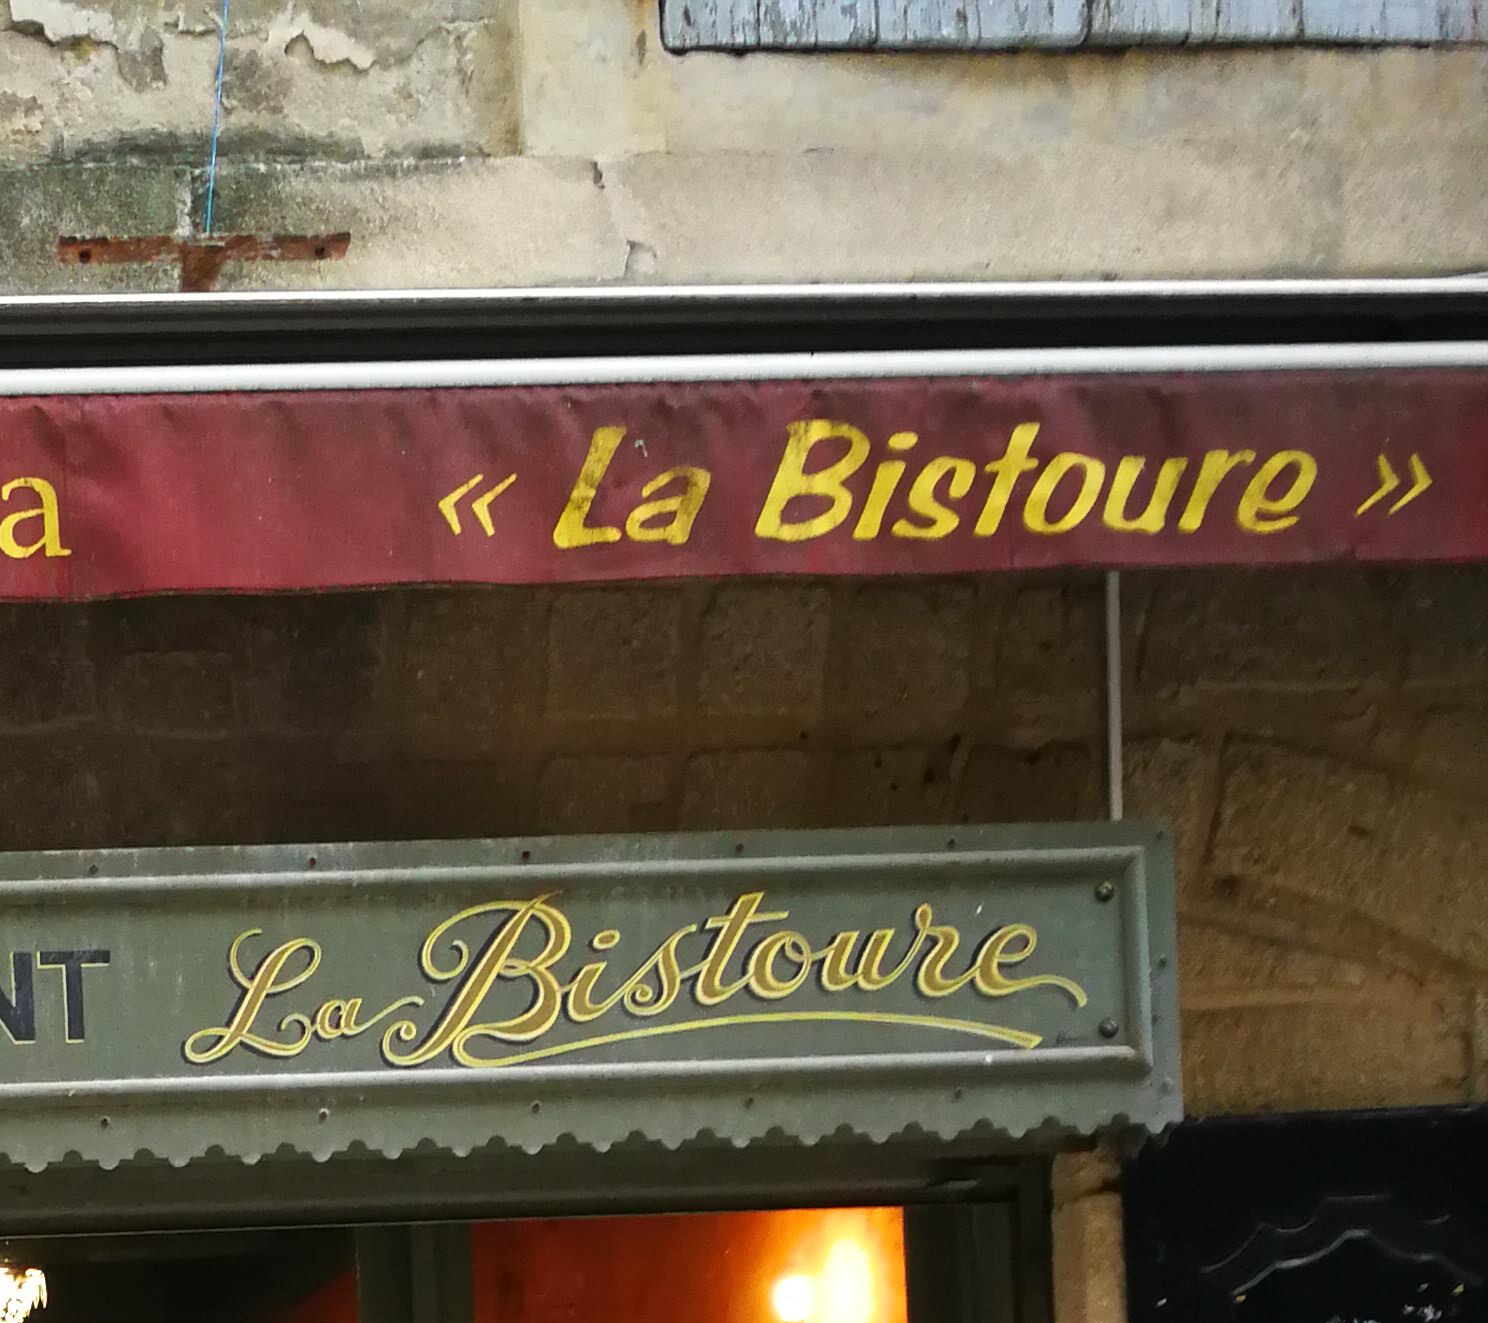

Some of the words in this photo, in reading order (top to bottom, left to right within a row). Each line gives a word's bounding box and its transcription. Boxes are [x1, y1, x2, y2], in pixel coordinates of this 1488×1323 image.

[552, 425, 711, 549] La
[755, 418, 1318, 544] Bistoure
[183, 928, 423, 1065] La
[383, 890, 1087, 1068] Bistoure
